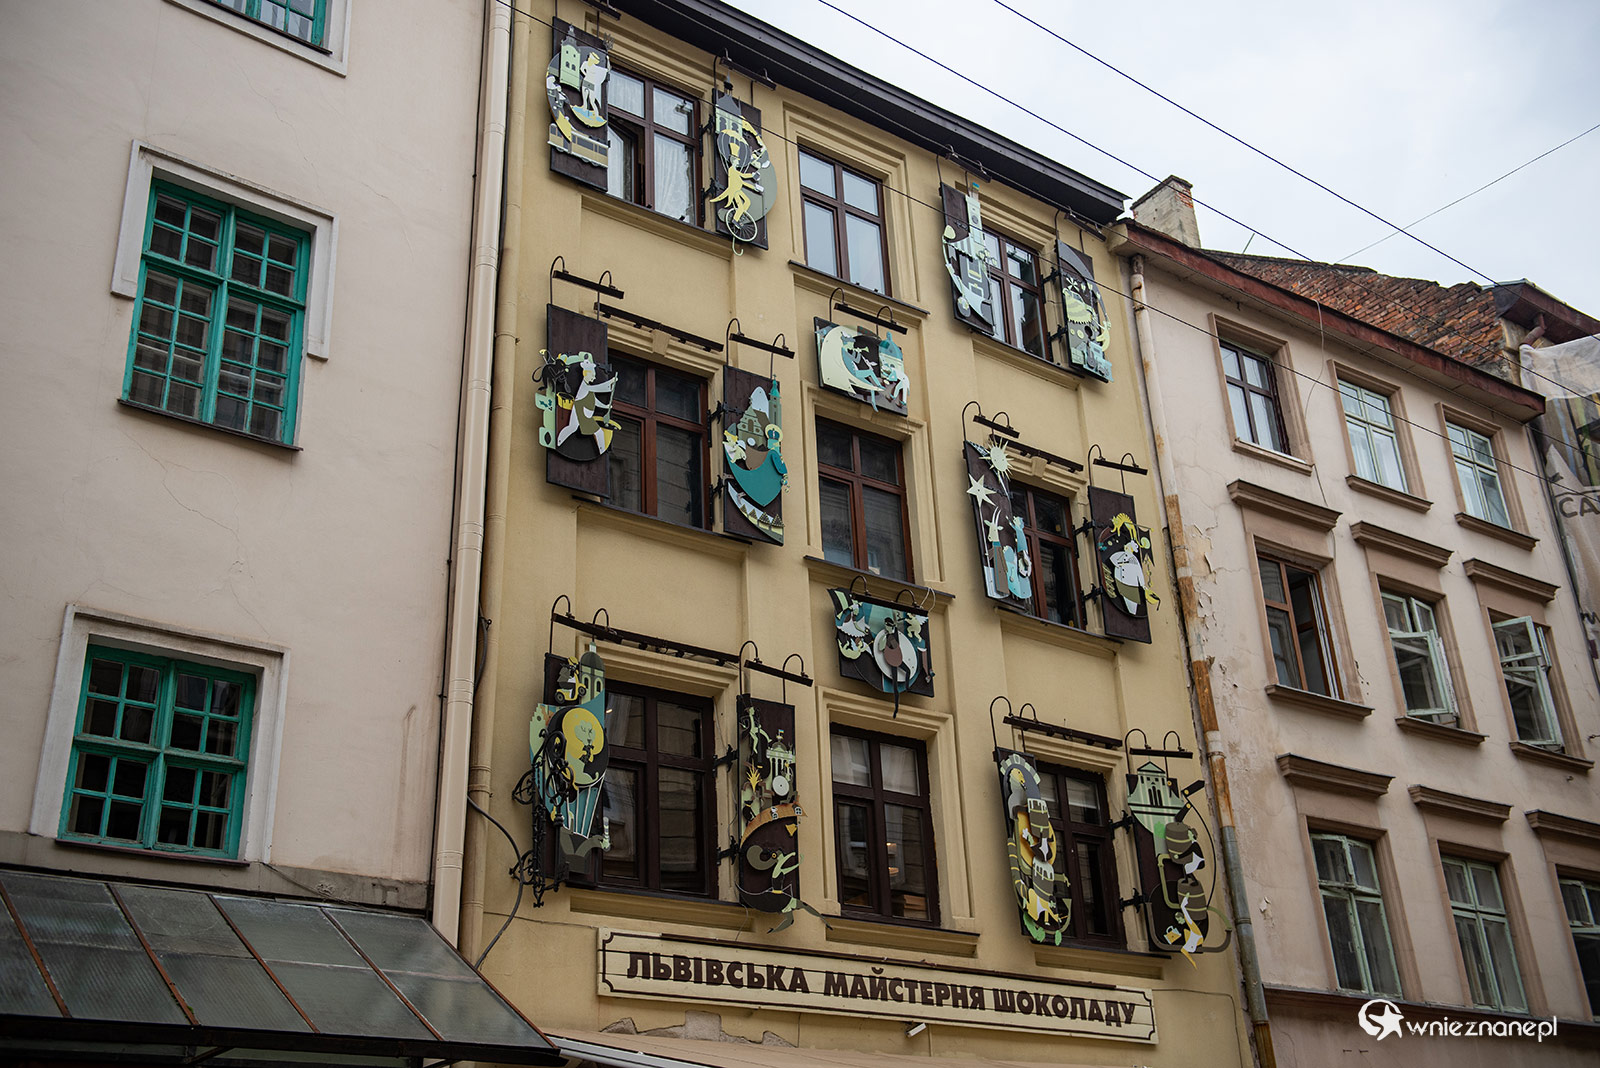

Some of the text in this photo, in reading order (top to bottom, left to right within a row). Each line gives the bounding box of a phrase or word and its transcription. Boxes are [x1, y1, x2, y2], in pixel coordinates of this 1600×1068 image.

[627, 951, 1135, 1027] ЛЬВІВСЬКА МАЙСТЕРНЯ ШОКОЛАДУ
